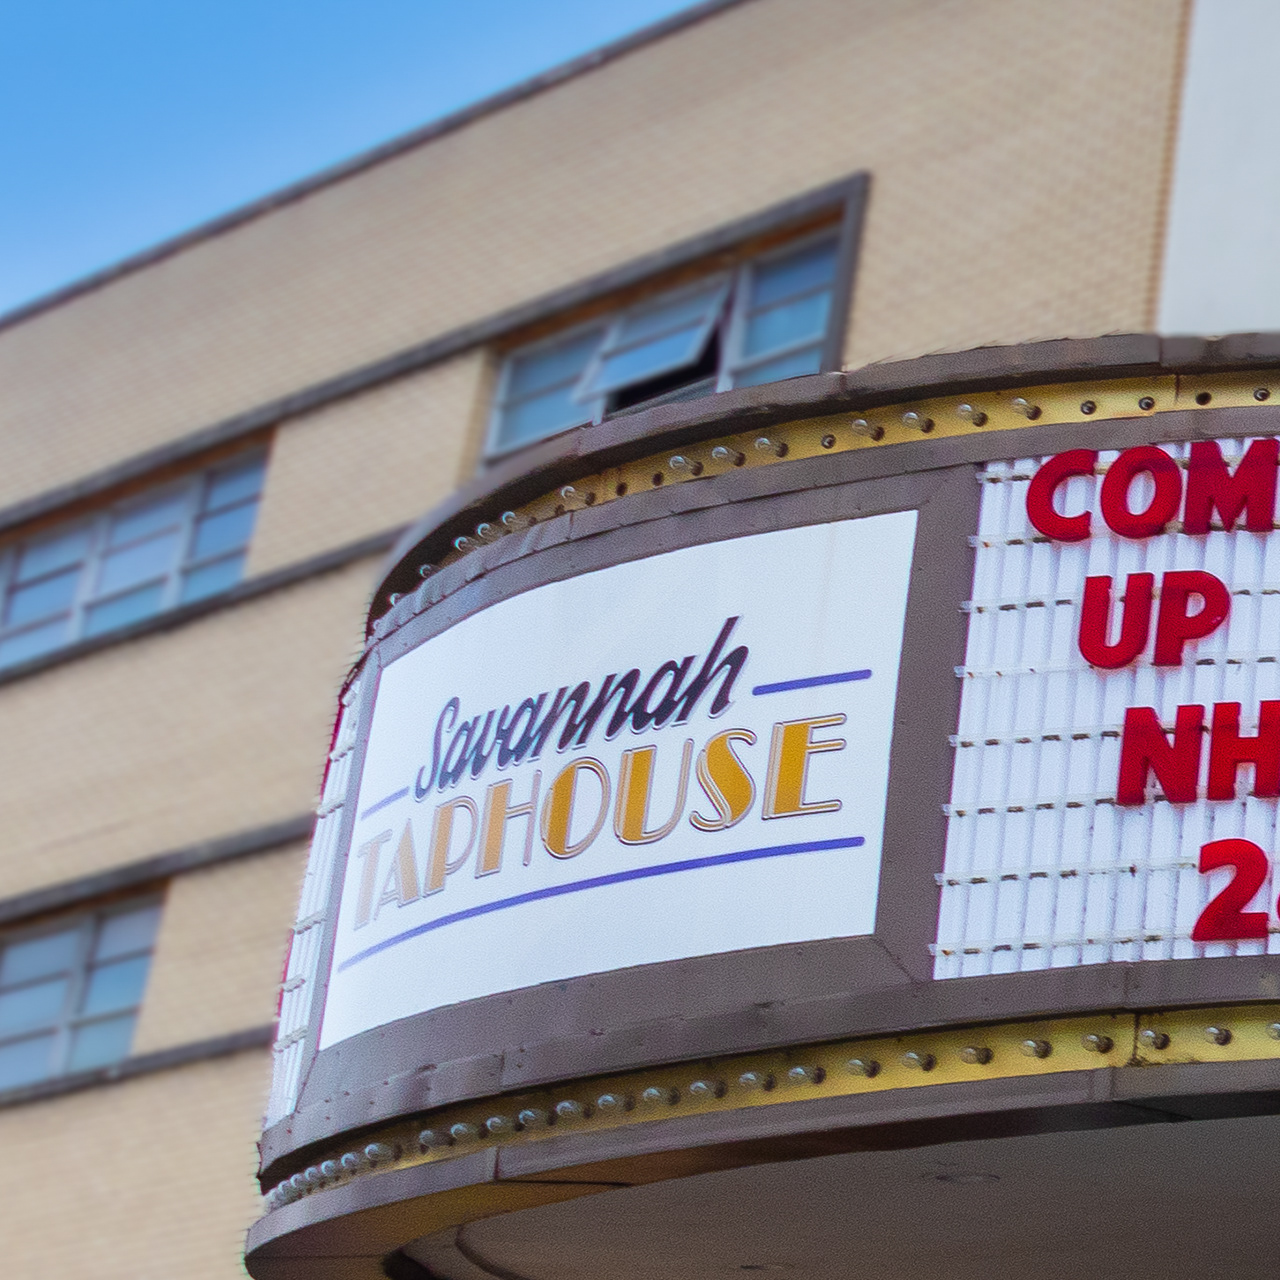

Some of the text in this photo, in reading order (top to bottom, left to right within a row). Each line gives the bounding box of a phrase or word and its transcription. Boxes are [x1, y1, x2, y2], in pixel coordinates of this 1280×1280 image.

[416, 615, 749, 801] Savannah
[1079, 570, 1230, 669] UP
[353, 712, 847, 932] TAPHOUSE
